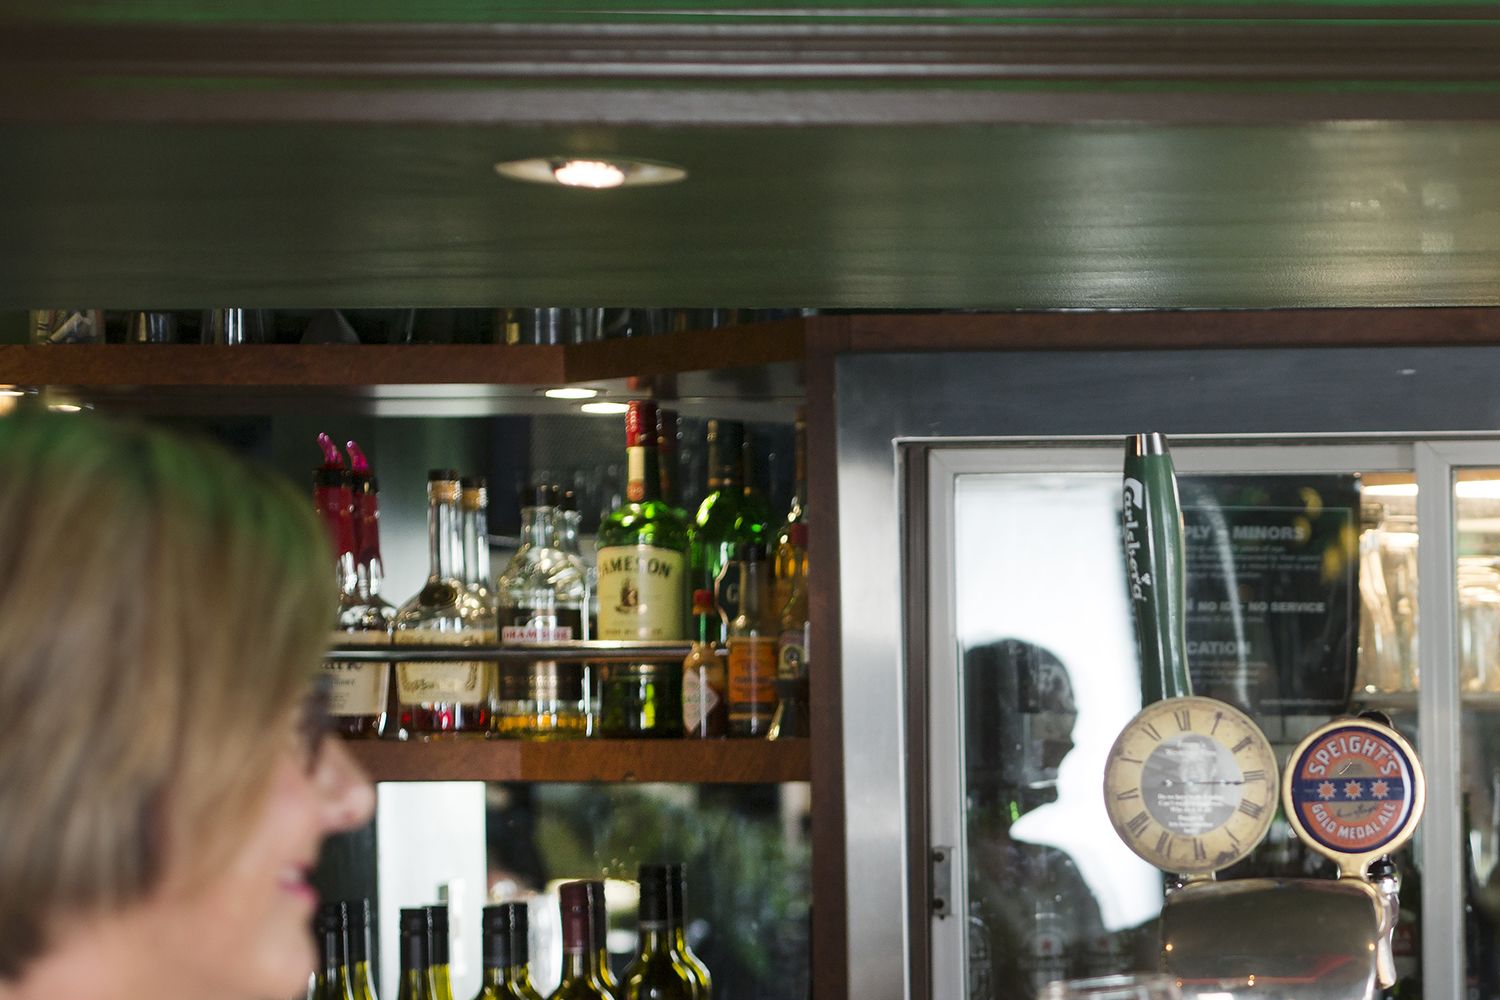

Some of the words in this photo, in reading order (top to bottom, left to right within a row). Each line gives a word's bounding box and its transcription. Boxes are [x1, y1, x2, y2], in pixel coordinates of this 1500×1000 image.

[1233, 525, 1305, 540] MINORS
[1248, 601, 1268, 612] NO
[1271, 601, 1326, 613] SERVICE
[1187, 641, 1252, 655] CATION
[1308, 735, 1398, 776] SPEIGHT'S
[1311, 803, 1338, 833] GOLD
[1337, 820, 1381, 840] MEDAL
[1377, 801, 1397, 826] ALE
